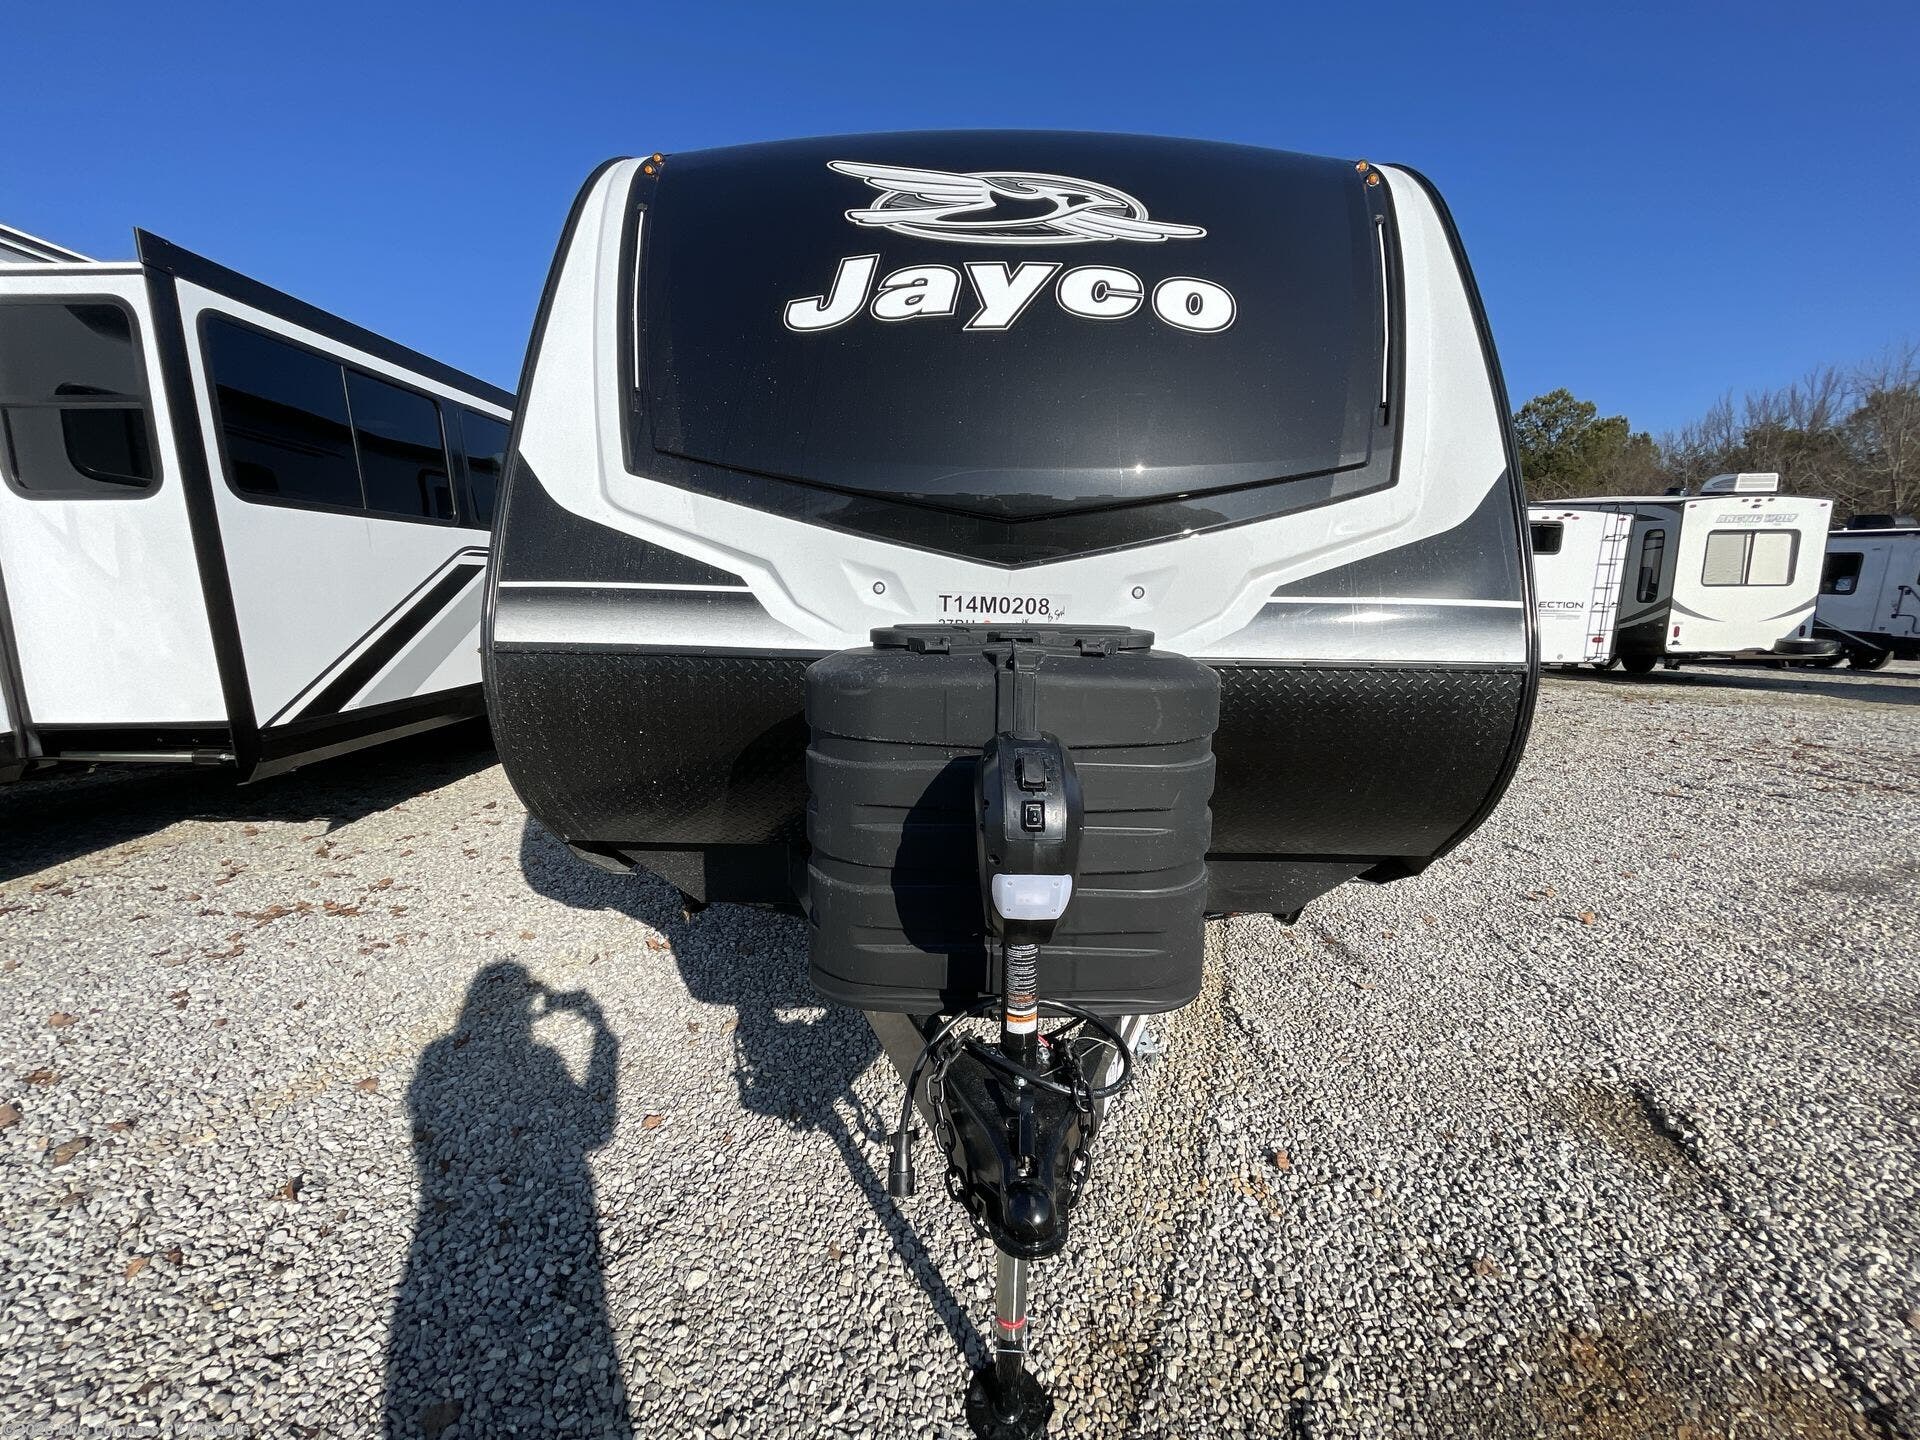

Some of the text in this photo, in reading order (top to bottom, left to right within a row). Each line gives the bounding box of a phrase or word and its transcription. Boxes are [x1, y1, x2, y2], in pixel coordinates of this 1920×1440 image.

[783, 253, 1238, 333] Jayco
[1715, 513, 1799, 523] ARCTIC WOLF
[938, 594, 1050, 616] T14M0208
